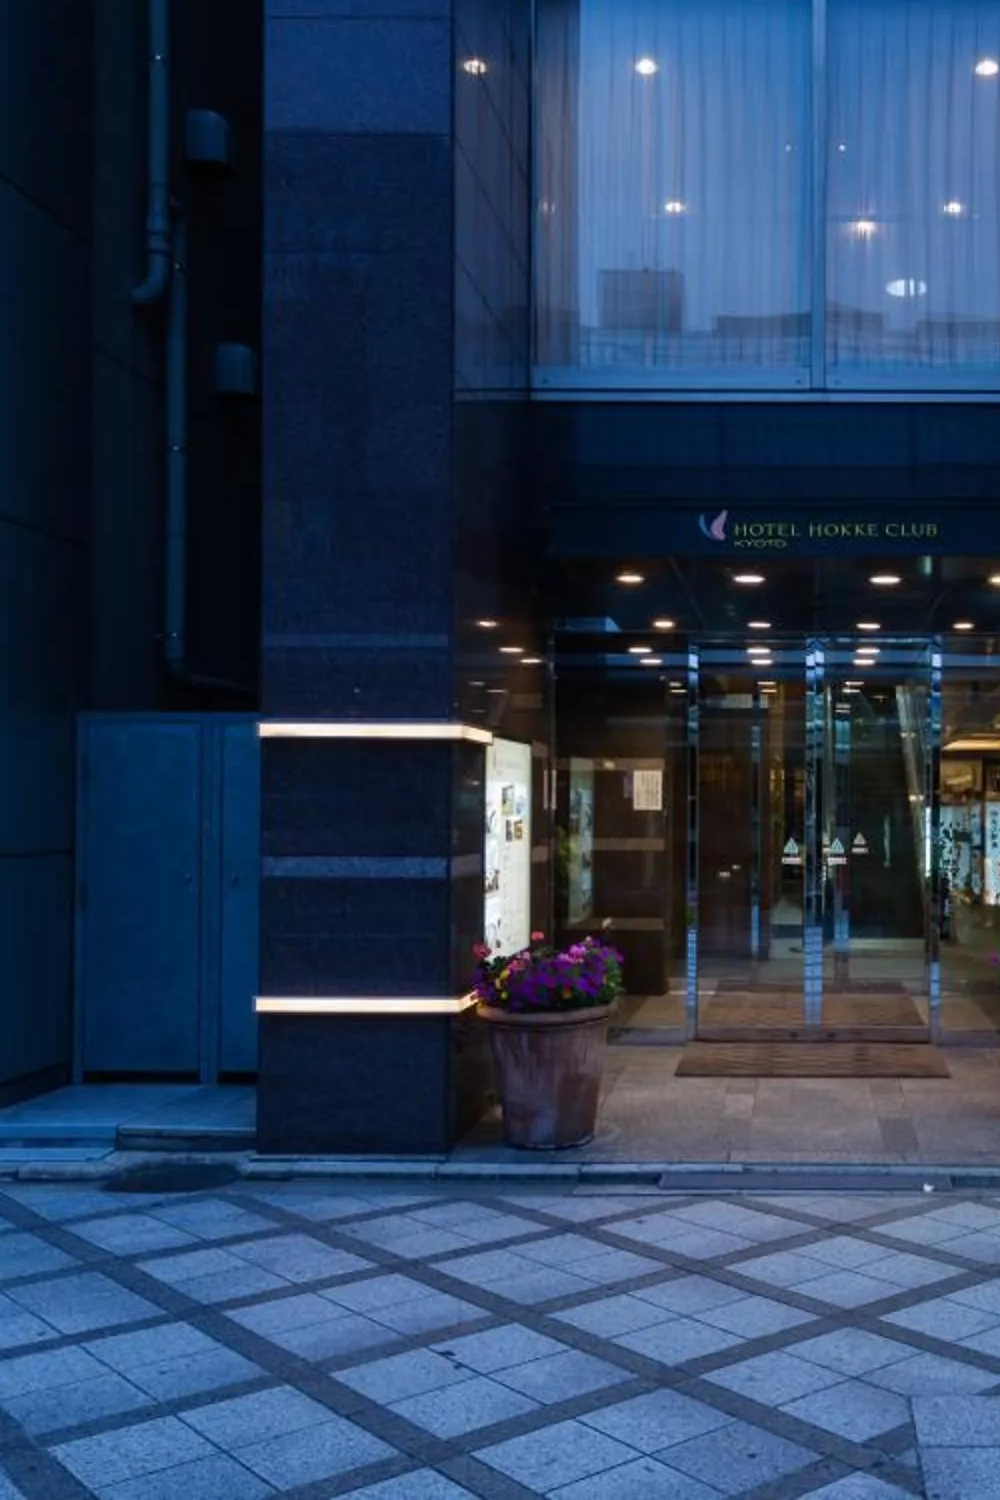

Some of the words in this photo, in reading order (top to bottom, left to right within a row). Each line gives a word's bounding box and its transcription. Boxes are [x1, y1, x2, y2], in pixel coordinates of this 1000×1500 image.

[734, 523, 800, 537] HOTEL
[809, 523, 878, 537] HOKKE
[885, 523, 938, 537] CLUB
[733, 539, 787, 548] KYOTO
